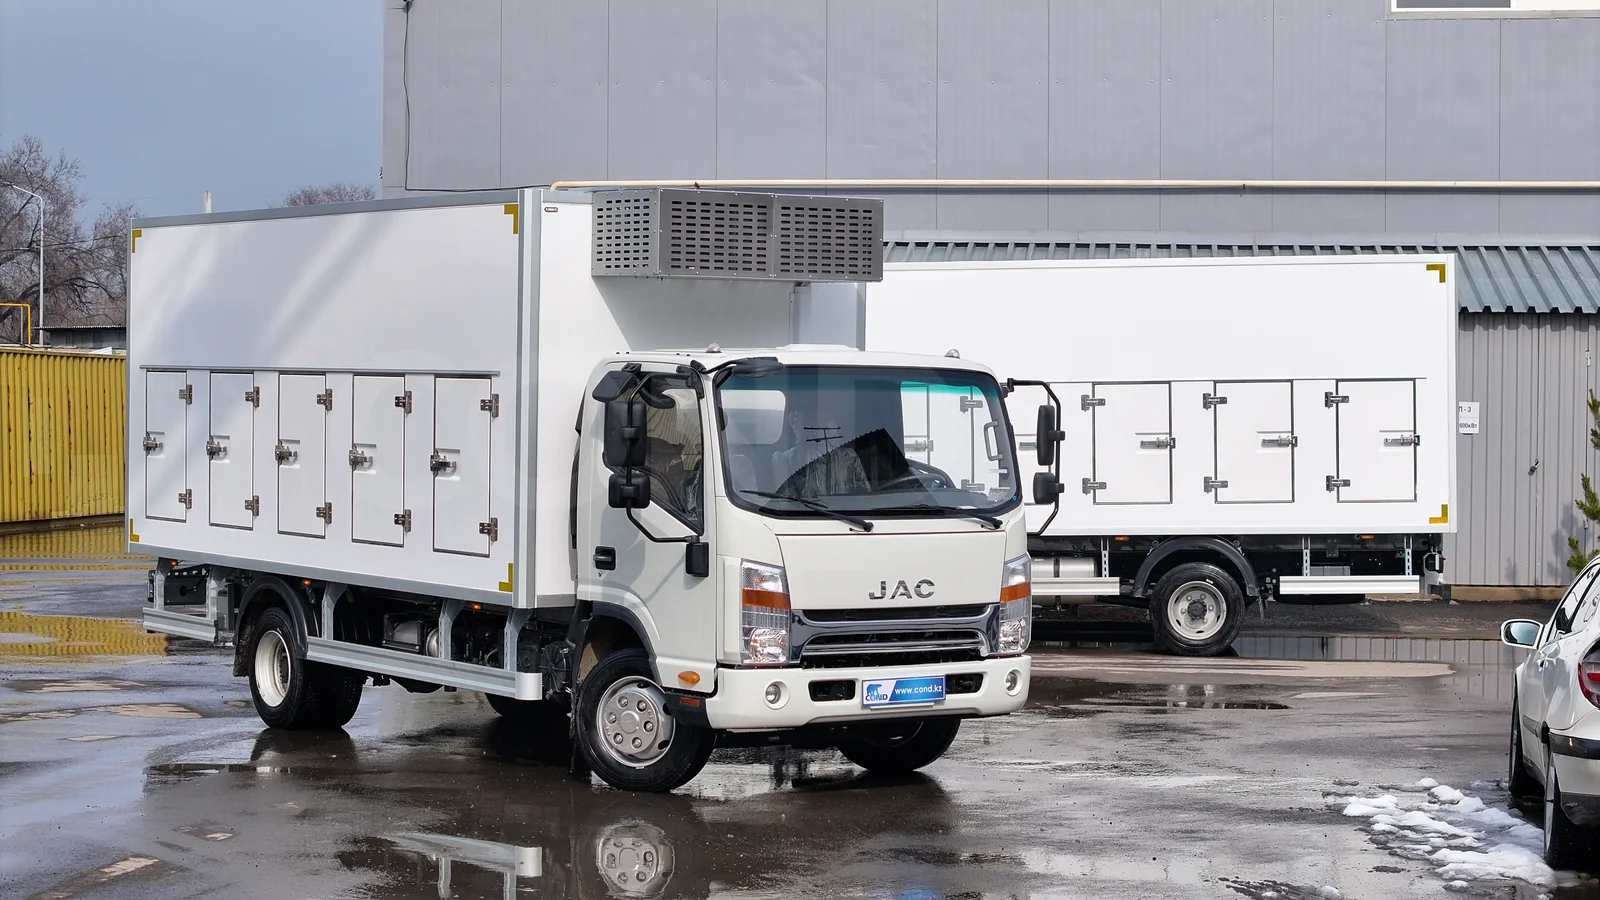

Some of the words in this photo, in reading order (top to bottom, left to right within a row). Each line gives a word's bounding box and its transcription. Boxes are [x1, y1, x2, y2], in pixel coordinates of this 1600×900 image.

[868, 578, 935, 600] JAC
[894, 684, 943, 695] www.cond.kz
[865, 693, 888, 702] COND
